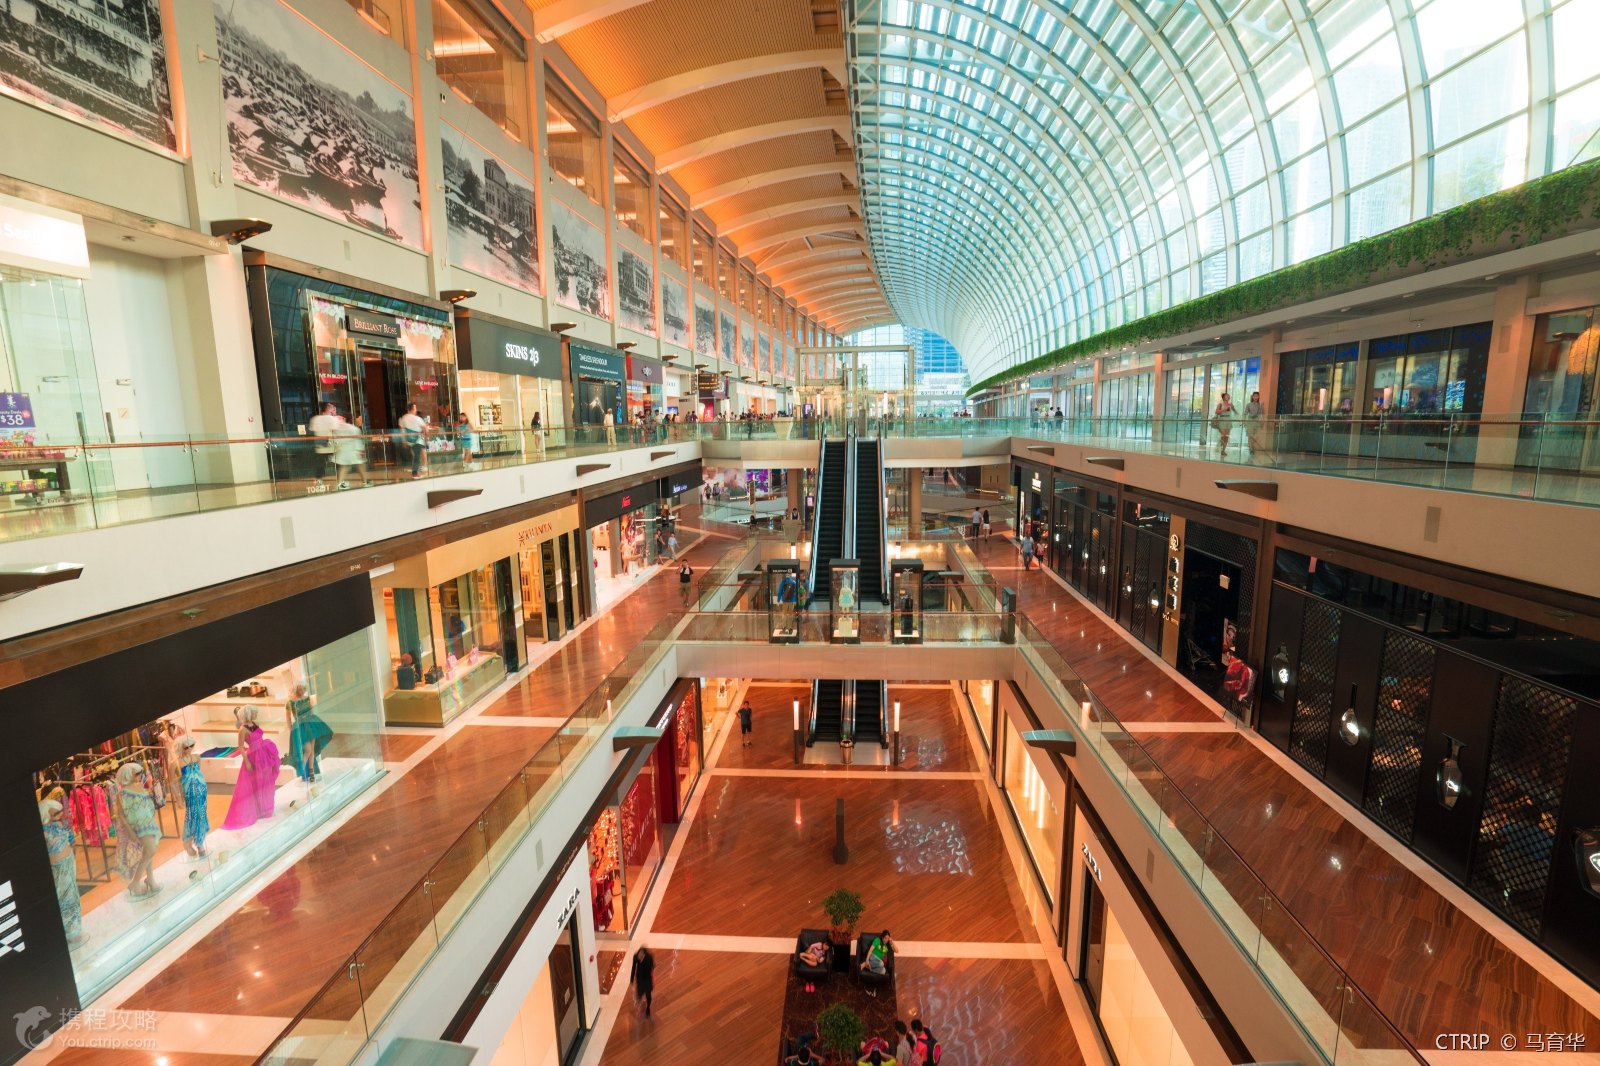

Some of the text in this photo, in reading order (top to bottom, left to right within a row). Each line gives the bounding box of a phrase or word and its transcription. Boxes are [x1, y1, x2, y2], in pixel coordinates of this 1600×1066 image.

[354, 318, 398, 335] BRILLIANT ROSE
[505, 343, 529, 361] SKINS
[0, 414, 24, 426] $38
[556, 887, 580, 930] ZARA
